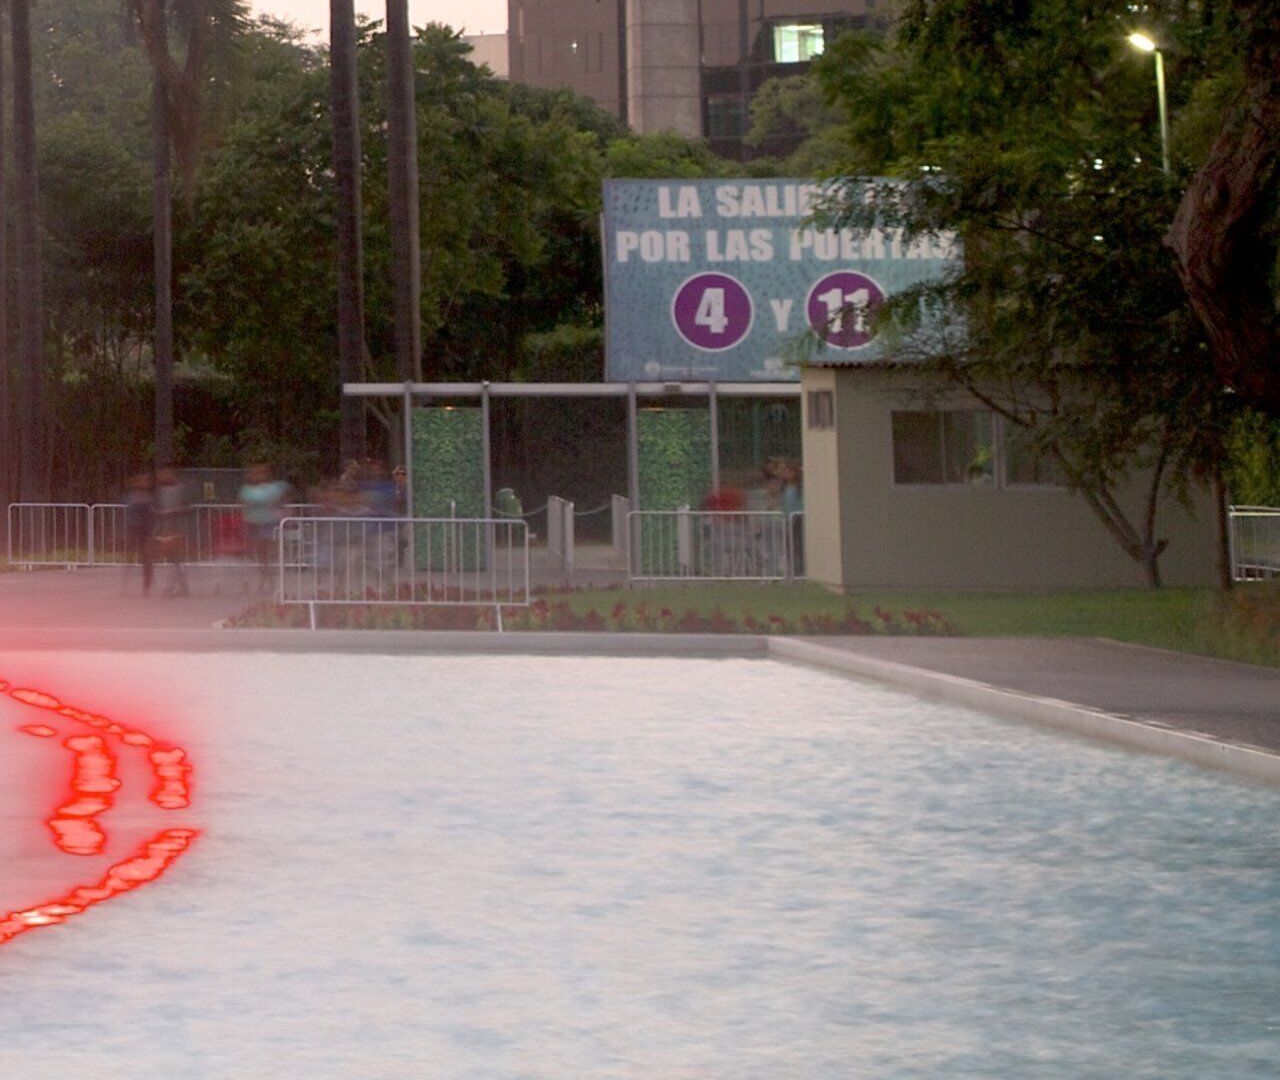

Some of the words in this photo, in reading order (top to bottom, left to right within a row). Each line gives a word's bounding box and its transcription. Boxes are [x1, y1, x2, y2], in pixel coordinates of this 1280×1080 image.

[658, 186, 703, 218] LA
[616, 230, 690, 262] POR
[706, 229, 774, 261] LAS
[694, 287, 728, 334] 4
[770, 298, 793, 332] Y
[817, 288, 870, 333] 11
